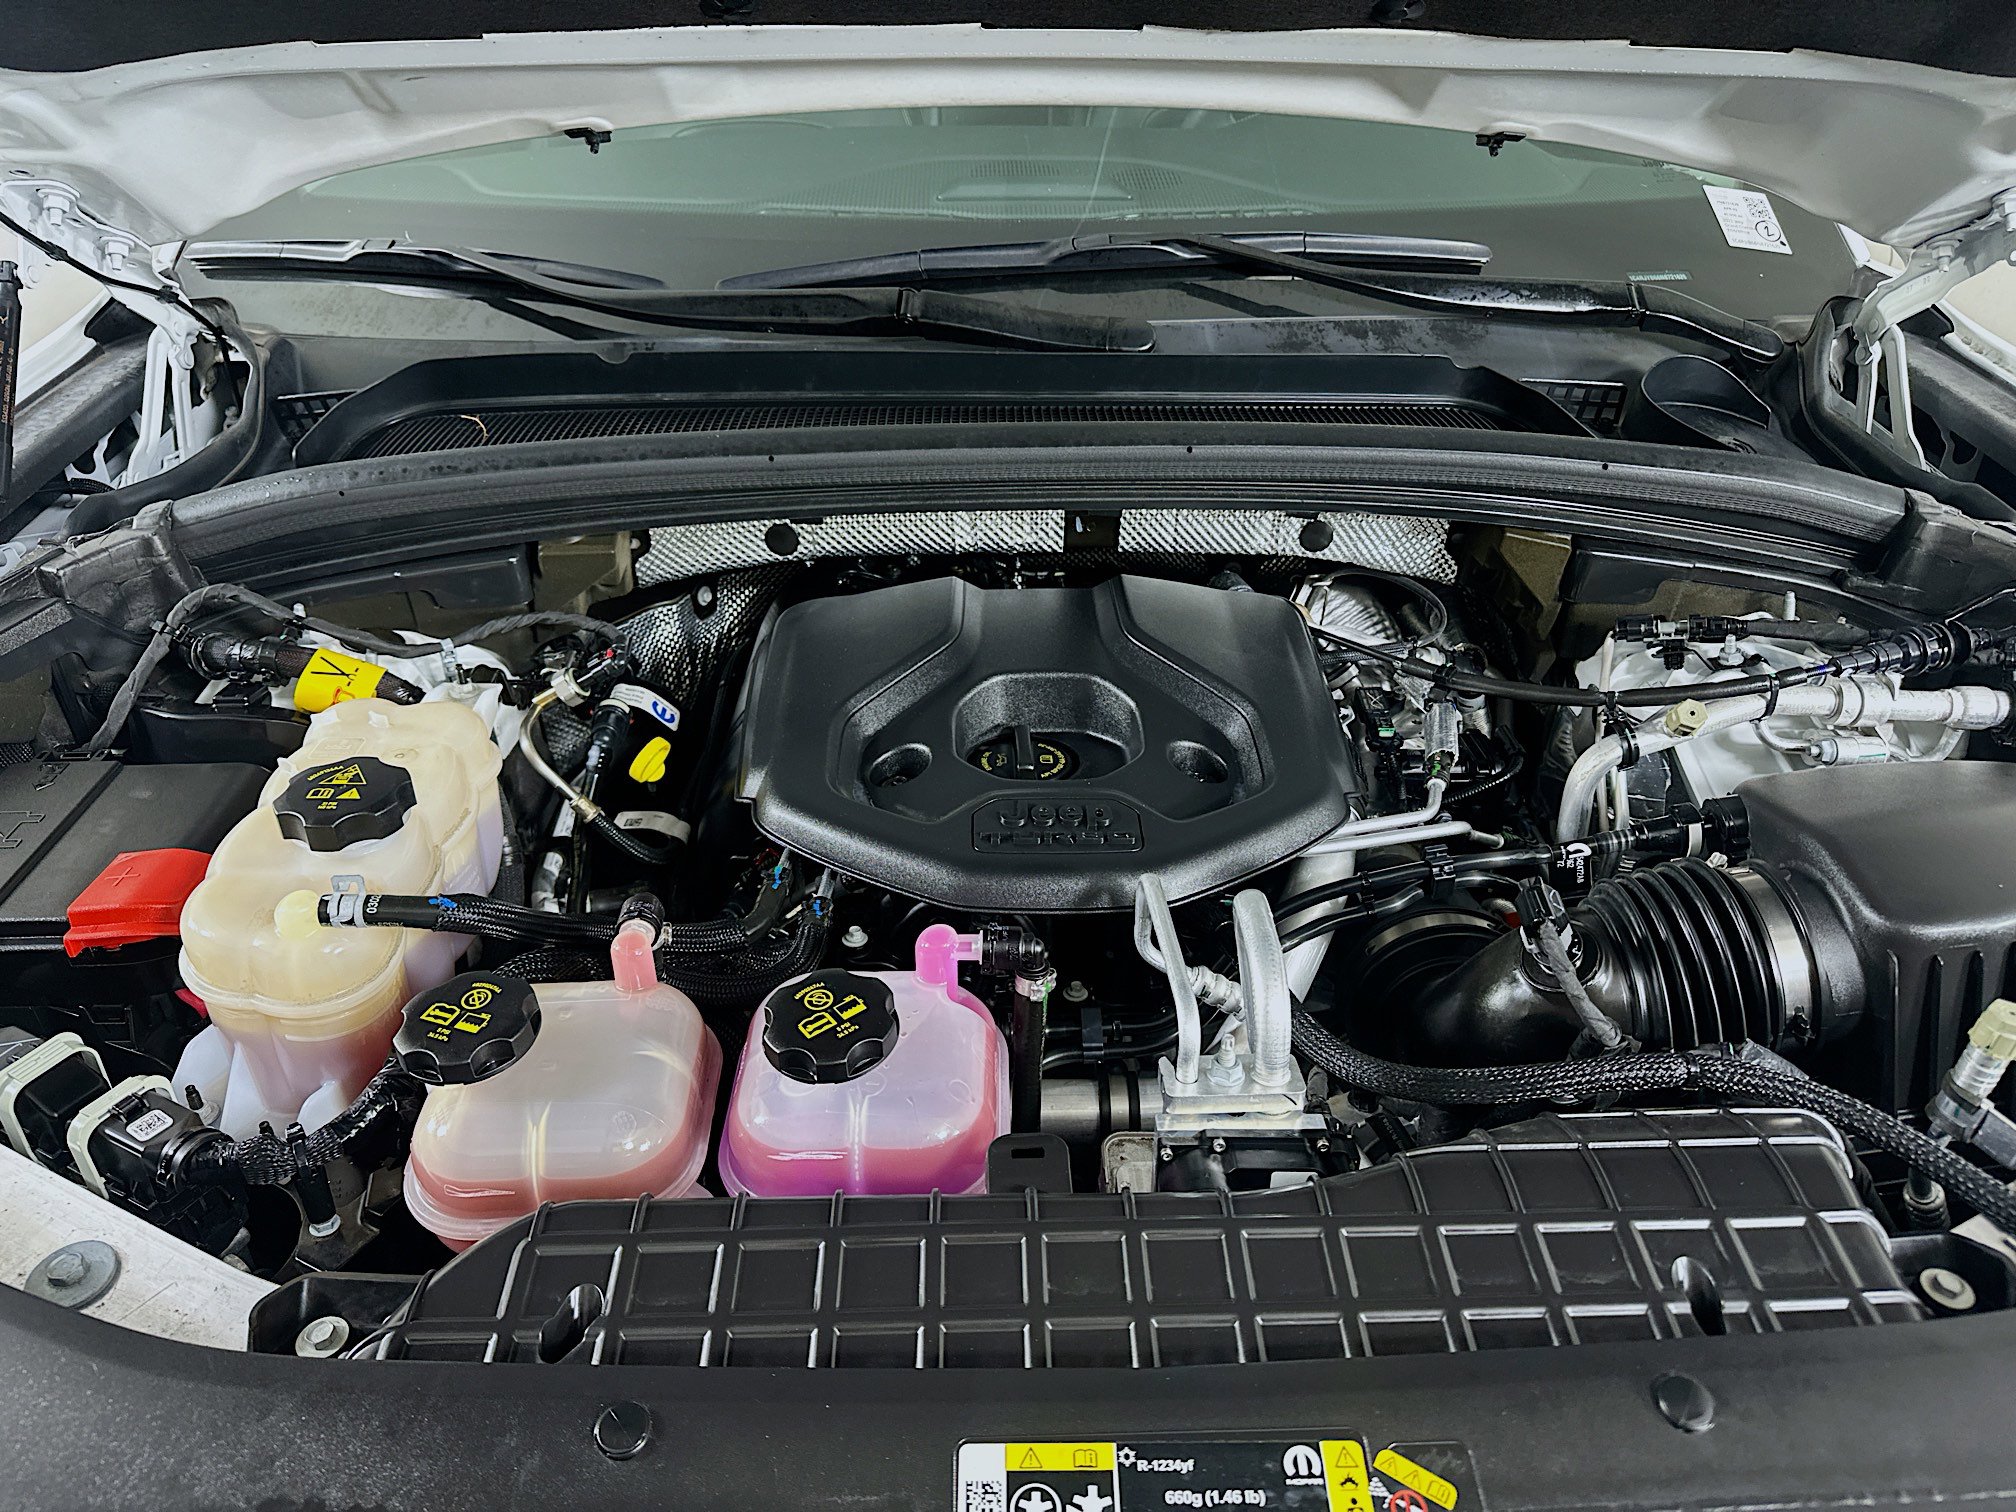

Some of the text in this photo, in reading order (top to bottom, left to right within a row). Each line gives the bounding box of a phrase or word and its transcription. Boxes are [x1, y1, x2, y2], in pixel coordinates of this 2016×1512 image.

[999, 799, 1113, 830] Jeep
[1136, 1459, 1195, 1475] R-1234yf
[1164, 1489, 1267, 1508] 660g (1.46 lb)
